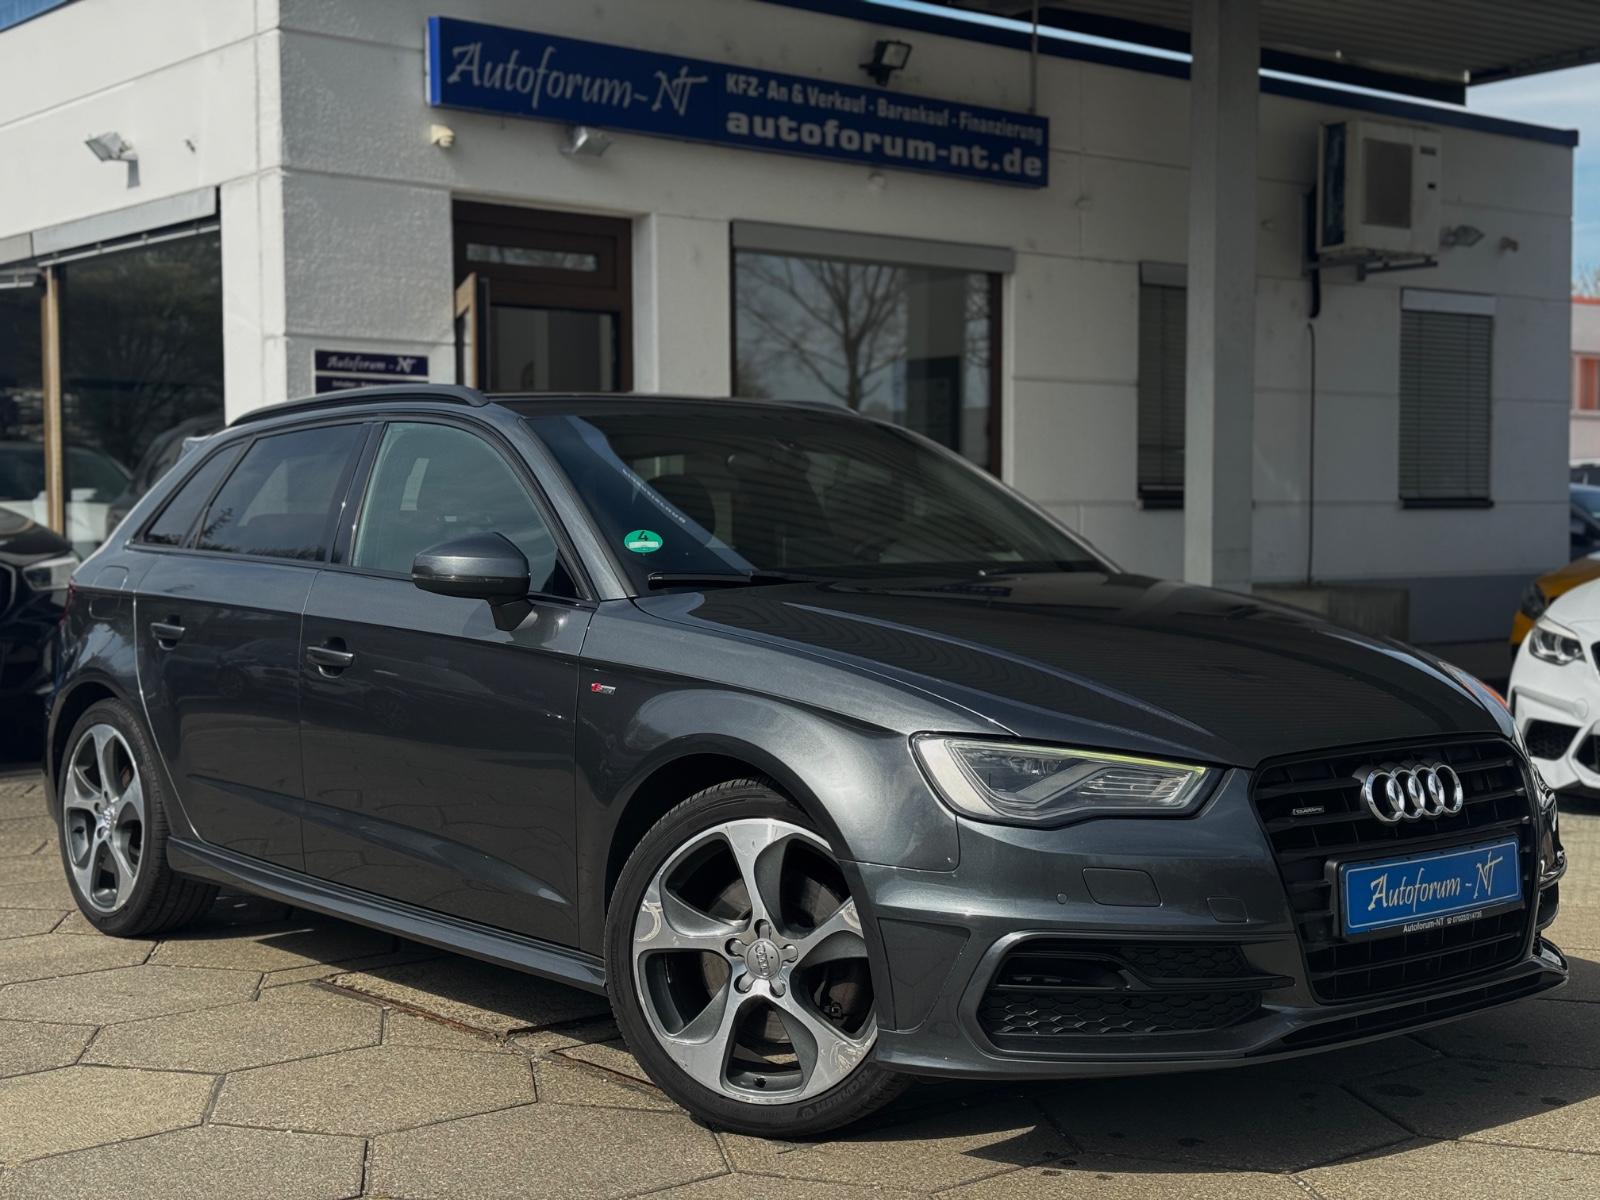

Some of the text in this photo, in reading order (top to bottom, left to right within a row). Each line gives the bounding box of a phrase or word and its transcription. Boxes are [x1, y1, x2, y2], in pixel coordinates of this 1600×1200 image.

[726, 111, 1042, 177] autoforum-nt.de
[767, 79, 789, 102] An
[792, 83, 804, 104] &
[807, 85, 867, 114] Verkauf
[877, 97, 949, 127] Barankauf
[959, 111, 1043, 147] Finanzierung
[638, 530, 649, 541] 4
[1368, 867, 1461, 913] Autoforum
[1473, 850, 1503, 899] NT
